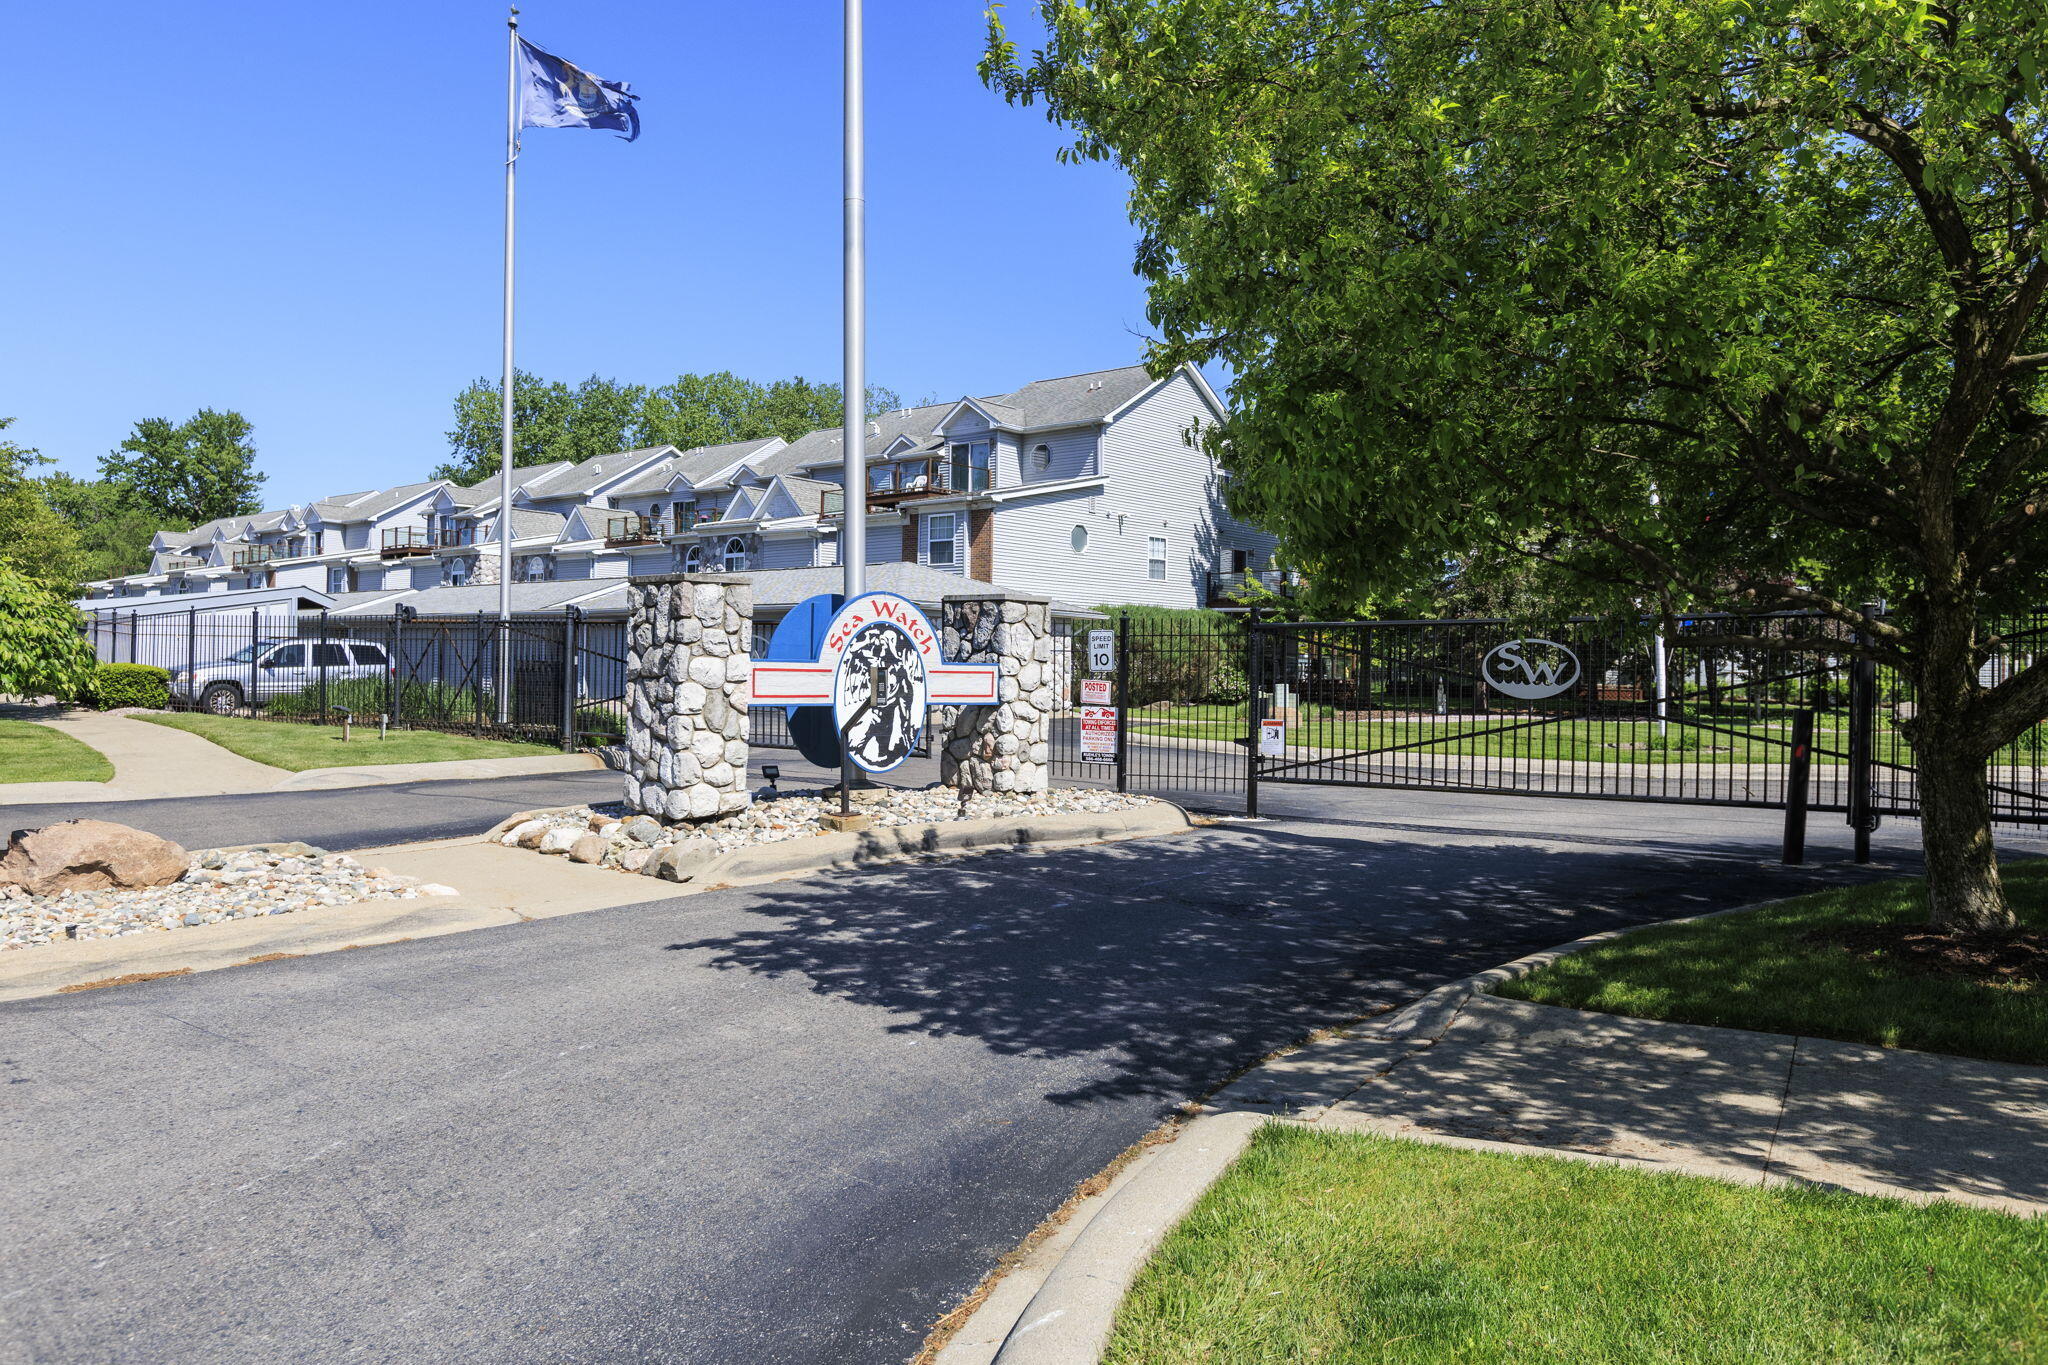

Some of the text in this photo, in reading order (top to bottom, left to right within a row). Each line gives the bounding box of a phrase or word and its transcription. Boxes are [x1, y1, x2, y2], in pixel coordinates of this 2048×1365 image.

[830, 599, 933, 655] Sea Watch
[1093, 653, 1109, 666] 10
[1497, 643, 1568, 684] SW
[1084, 682, 1107, 692] POSTED
